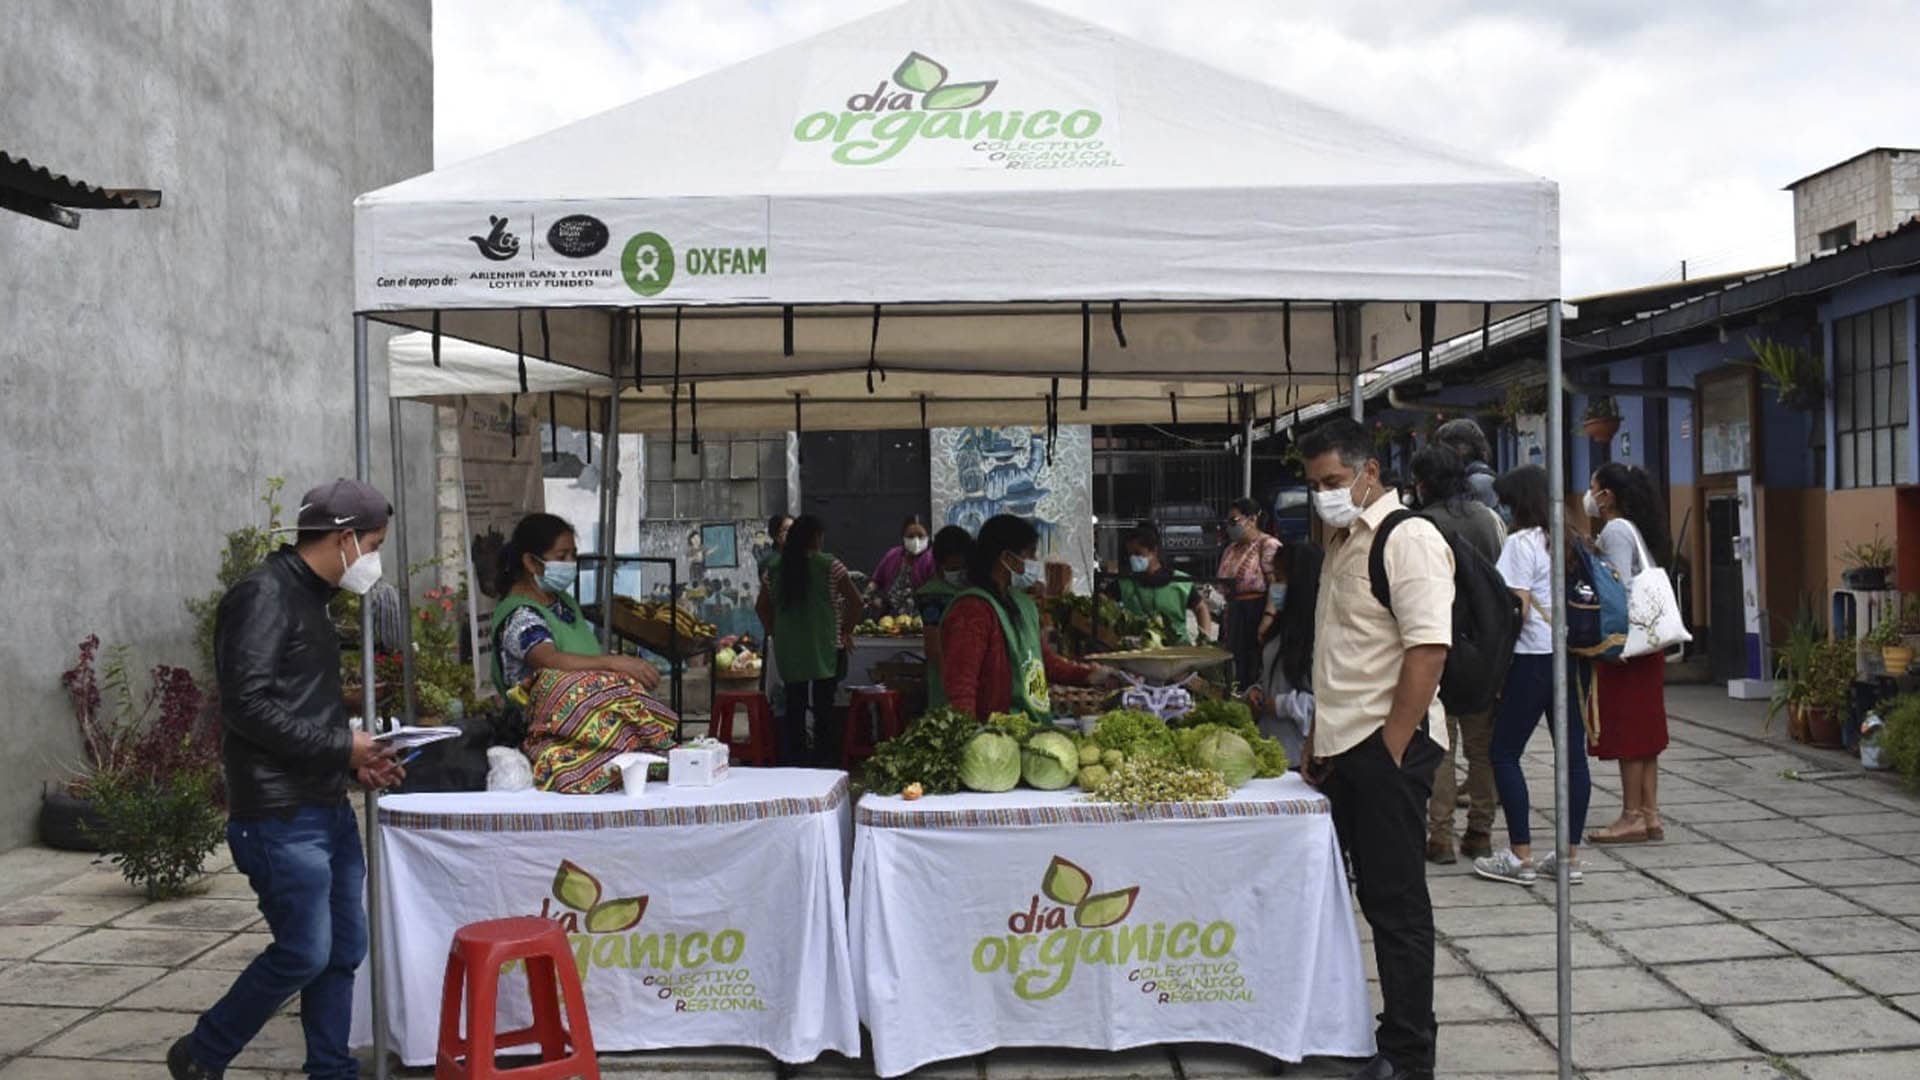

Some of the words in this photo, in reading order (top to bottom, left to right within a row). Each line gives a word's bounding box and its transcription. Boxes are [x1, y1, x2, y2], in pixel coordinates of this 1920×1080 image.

[973, 140, 1105, 152] COLECTIVO
[1005, 160, 1126, 169] REGIONAL
[685, 247, 767, 276] OXFAM
[529, 270, 556, 279] GAN
[559, 270, 568, 278] Y
[571, 269, 613, 278] LOTERI
[376, 276, 396, 288] Con
[398, 275, 407, 287] el
[408, 277, 440, 289] apoyo
[489, 279, 540, 289] LOTTERY
[544, 279, 594, 288] FUNDED
[643, 969, 750, 987] COLECTIVO
[1128, 961, 1239, 982] COLECTIVO
[658, 983, 756, 1000] ORGANICO
[1142, 976, 1245, 994] ORGANICO
[1158, 990, 1255, 1004] REGIONAL
[675, 999, 768, 1013] REGIONAL
